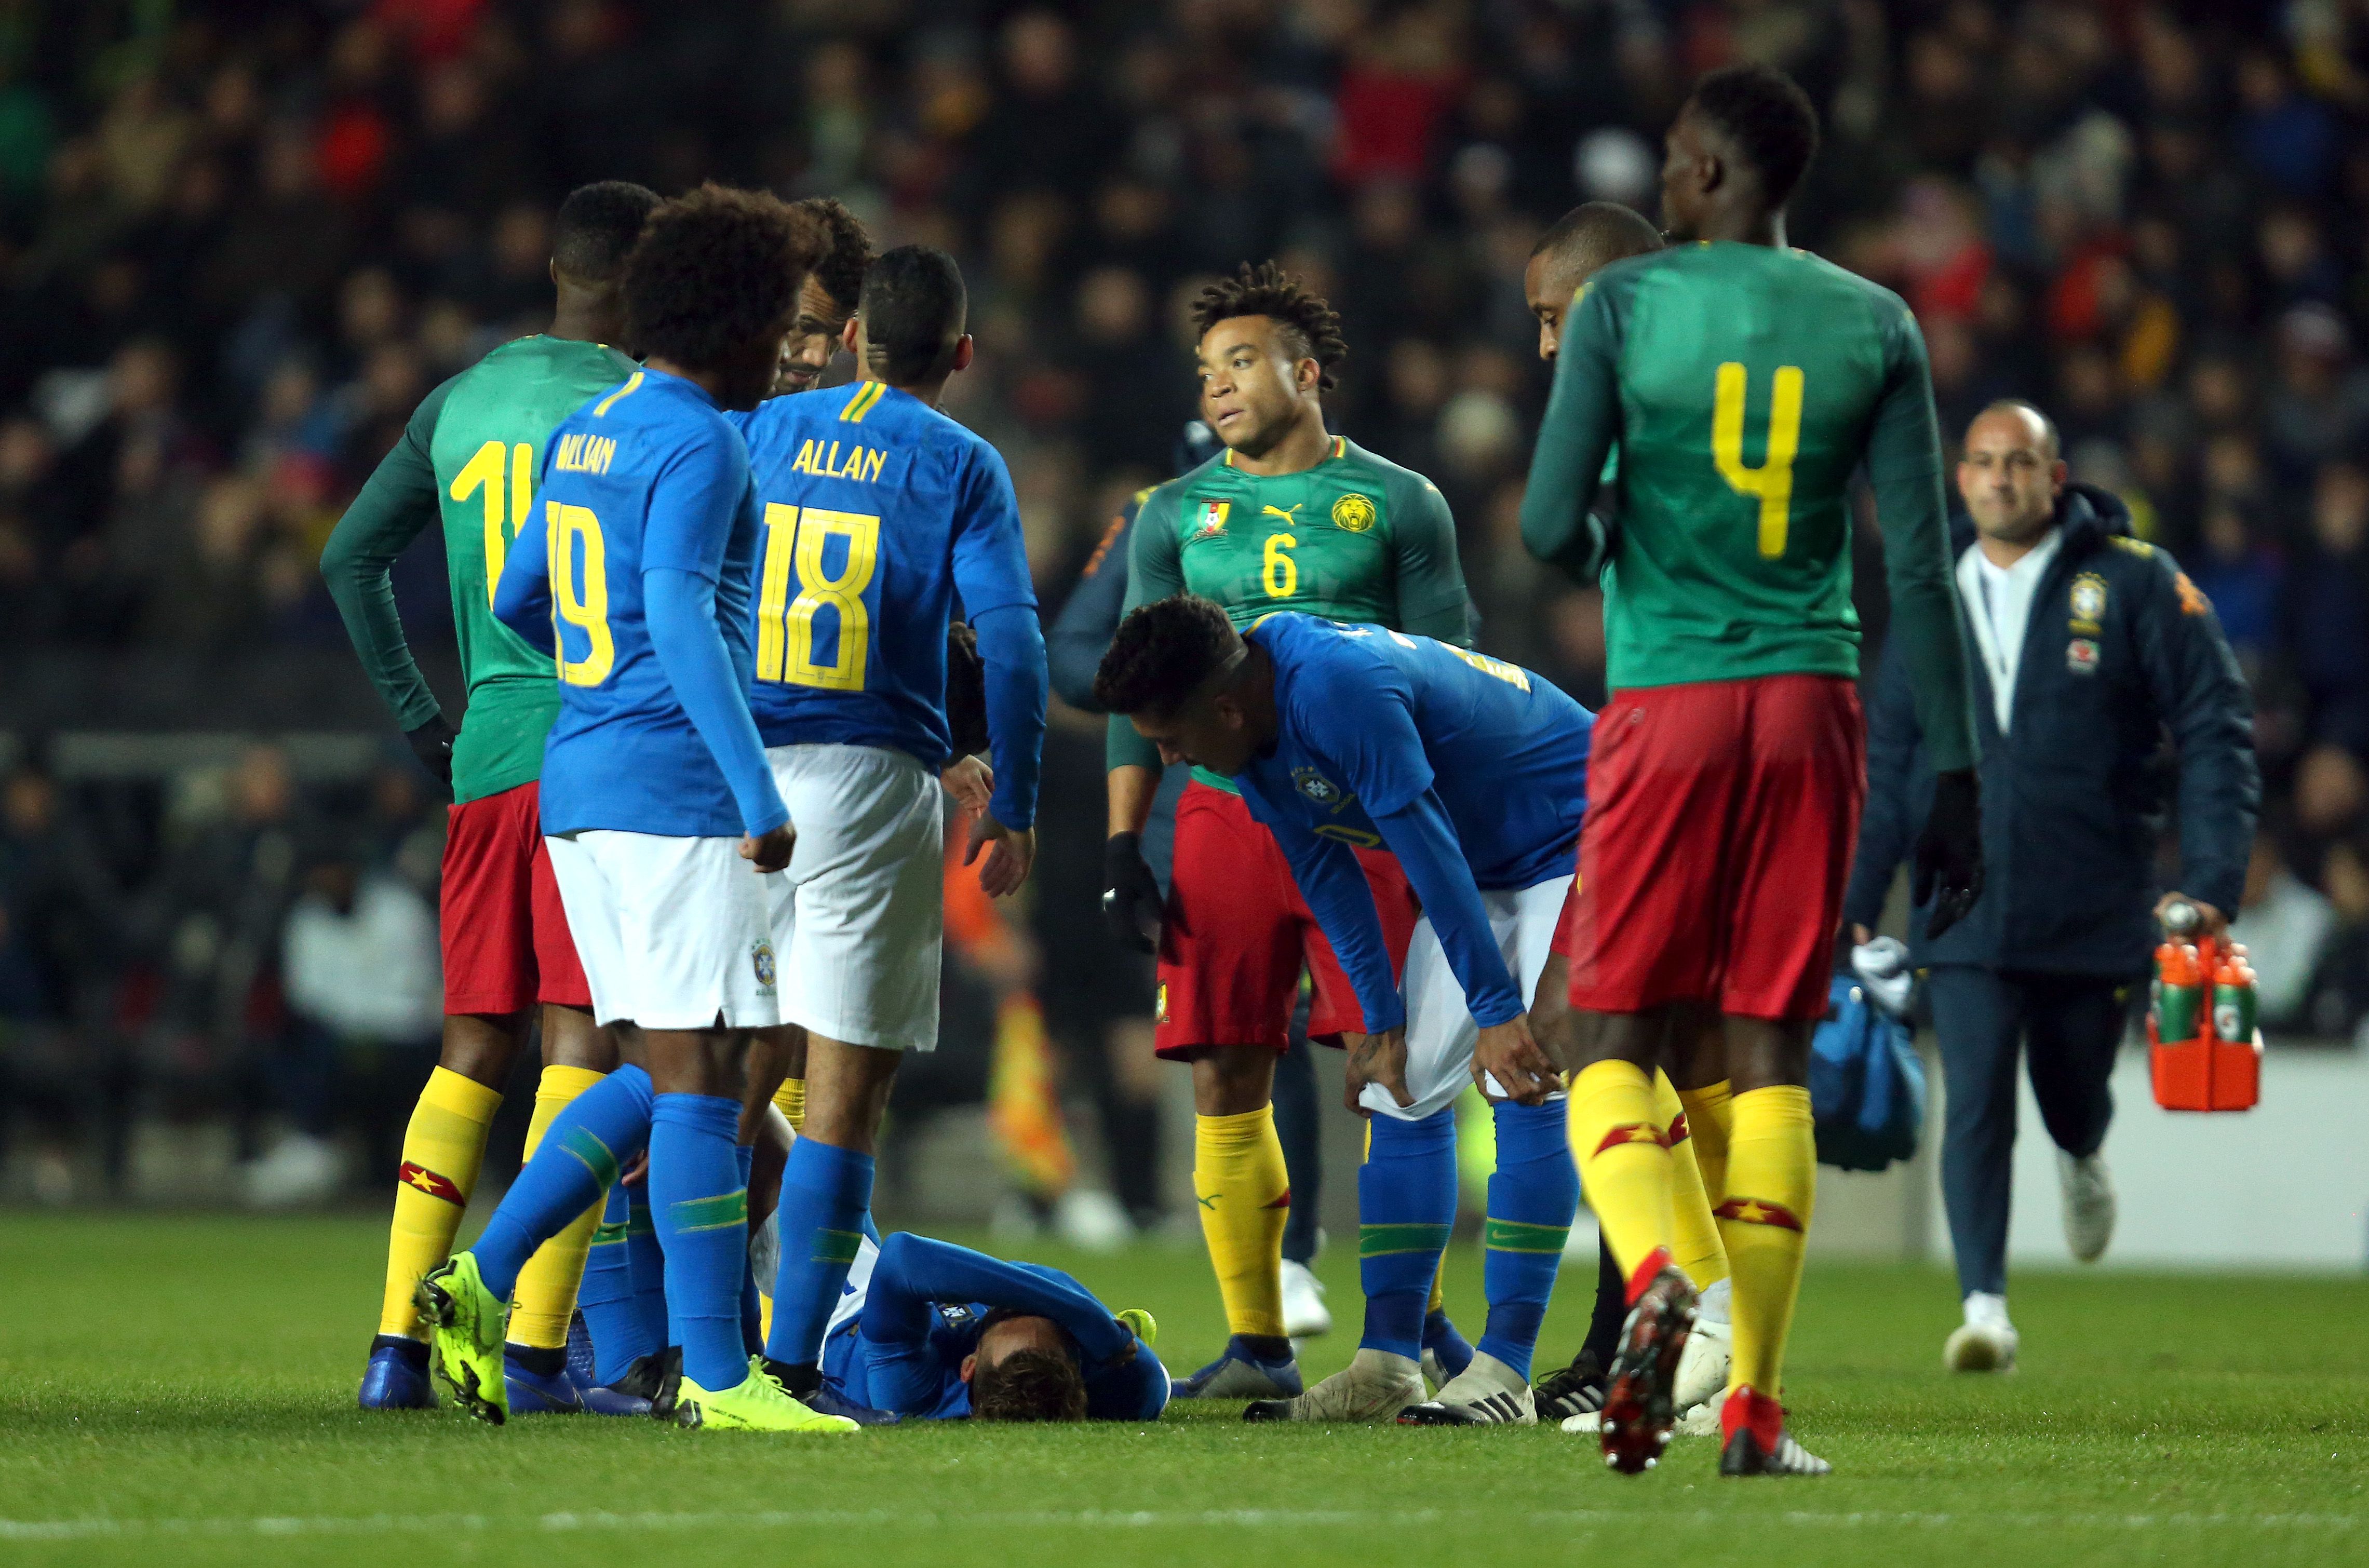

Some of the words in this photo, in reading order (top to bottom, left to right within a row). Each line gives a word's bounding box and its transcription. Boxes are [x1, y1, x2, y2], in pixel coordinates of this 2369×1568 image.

[792, 439, 887, 482] ALLAN
[1711, 361, 1805, 560] 4
[546, 500, 615, 687] 19
[756, 502, 881, 691] 18
[1262, 532, 1297, 598] 6
